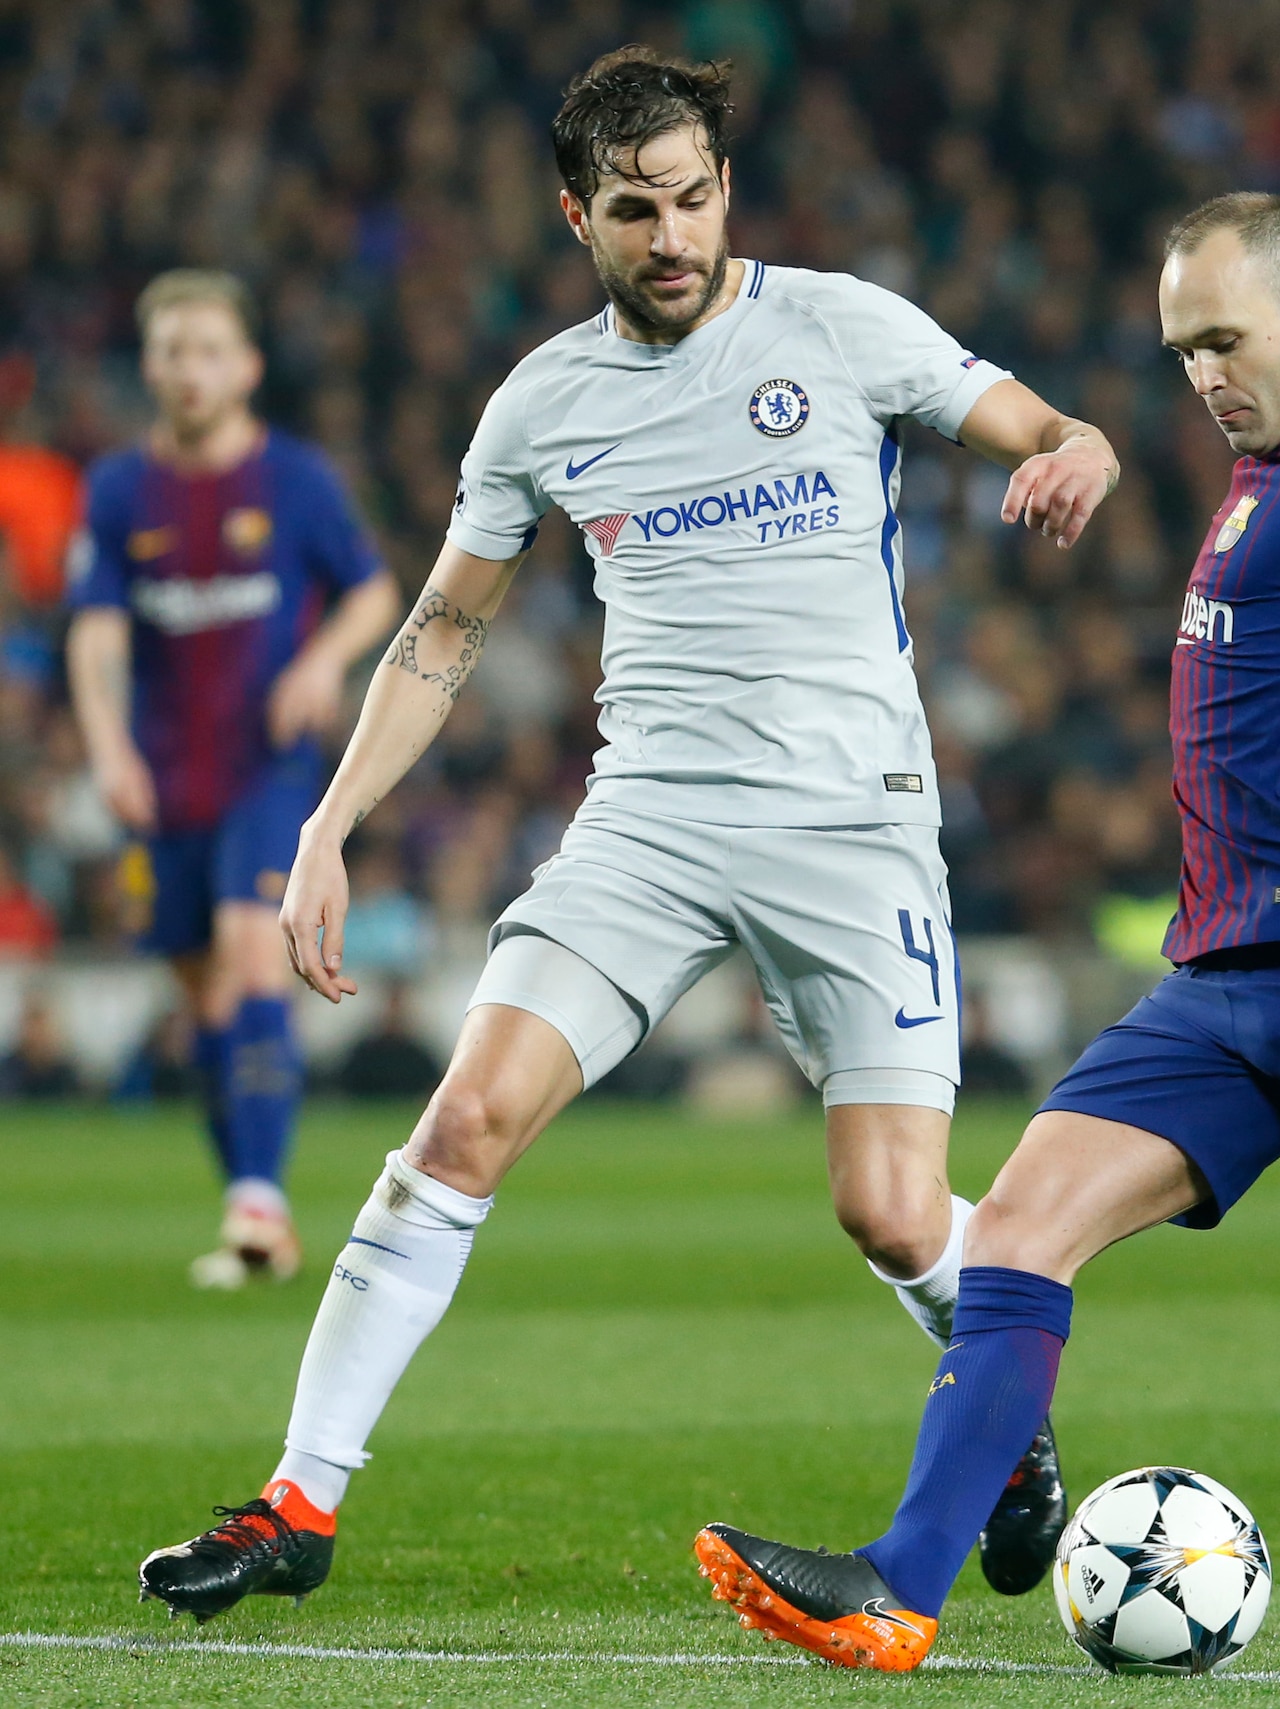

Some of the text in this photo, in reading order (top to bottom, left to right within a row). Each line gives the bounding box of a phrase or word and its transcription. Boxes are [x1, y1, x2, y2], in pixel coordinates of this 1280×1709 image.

[755, 380, 793, 398] CHELSEA
[632, 471, 838, 542] YOKOHAMA
[757, 505, 839, 543] TYRES
[897, 908, 940, 1006] 4
[335, 1264, 368, 1291] CFC
[1081, 1564, 1095, 1604] adidas
